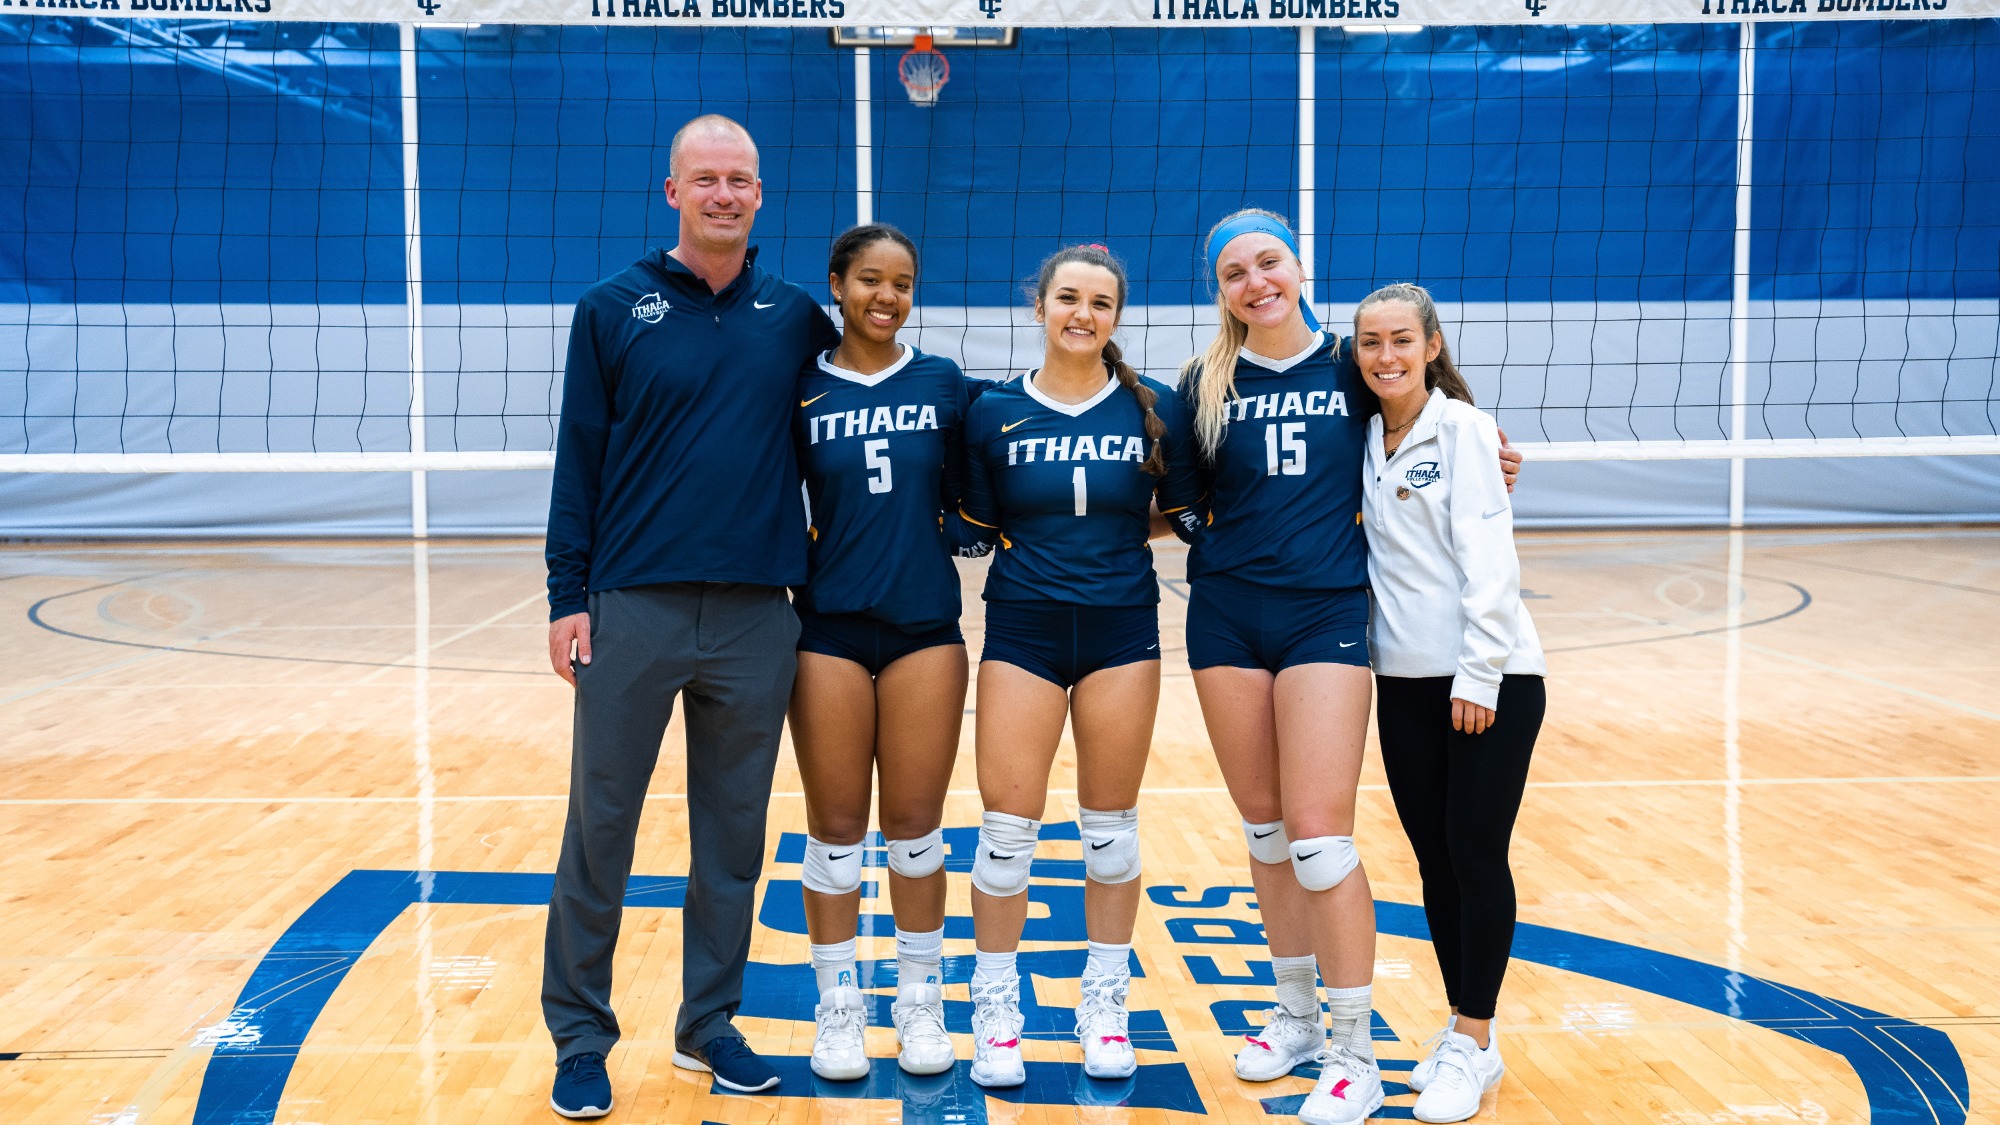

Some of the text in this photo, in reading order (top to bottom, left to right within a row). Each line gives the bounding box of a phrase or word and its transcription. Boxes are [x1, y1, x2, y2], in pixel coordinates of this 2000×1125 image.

[711, 0, 844, 18] BOMBERS
[1269, 0, 1399, 18] BOMBERS
[632, 300, 670, 318] ITHACA
[810, 404, 938, 445] ITHACA
[1222, 391, 1349, 425] ITHACA
[1007, 434, 1144, 466] ITHACA
[1265, 422, 1306, 476] 15
[864, 438, 893, 494] 5
[1405, 470, 1440, 479] ITHACA
[1072, 466, 1087, 516] 1
